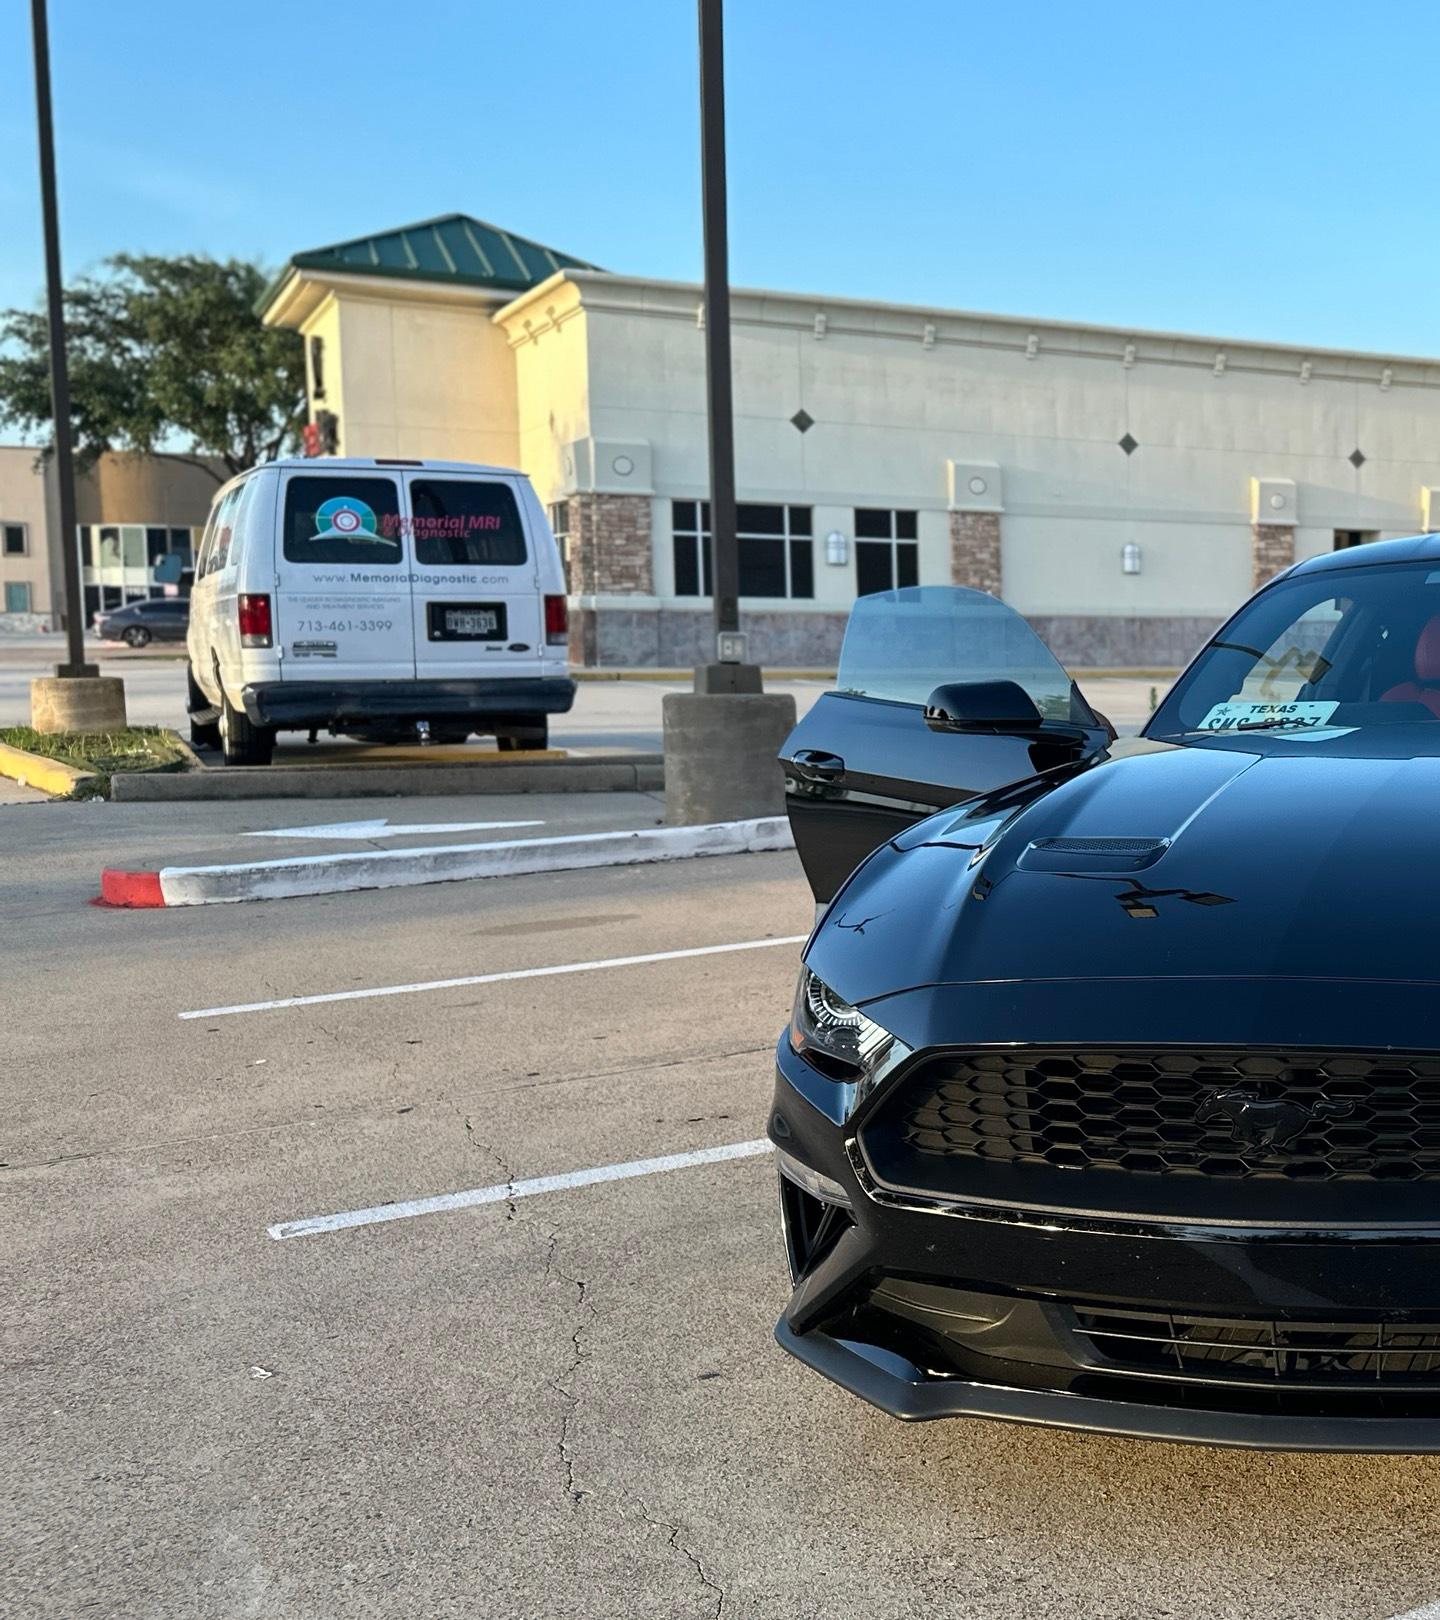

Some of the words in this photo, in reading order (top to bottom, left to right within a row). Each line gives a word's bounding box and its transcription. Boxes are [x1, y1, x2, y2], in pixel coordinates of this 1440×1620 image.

[382, 514, 465, 529] Memorial
[469, 515, 501, 529] MRI
[398, 526, 471, 540] Diagnostic
[297, 620, 393, 632] 713-461-3399
[1249, 704, 1298, 714] TEXAS
